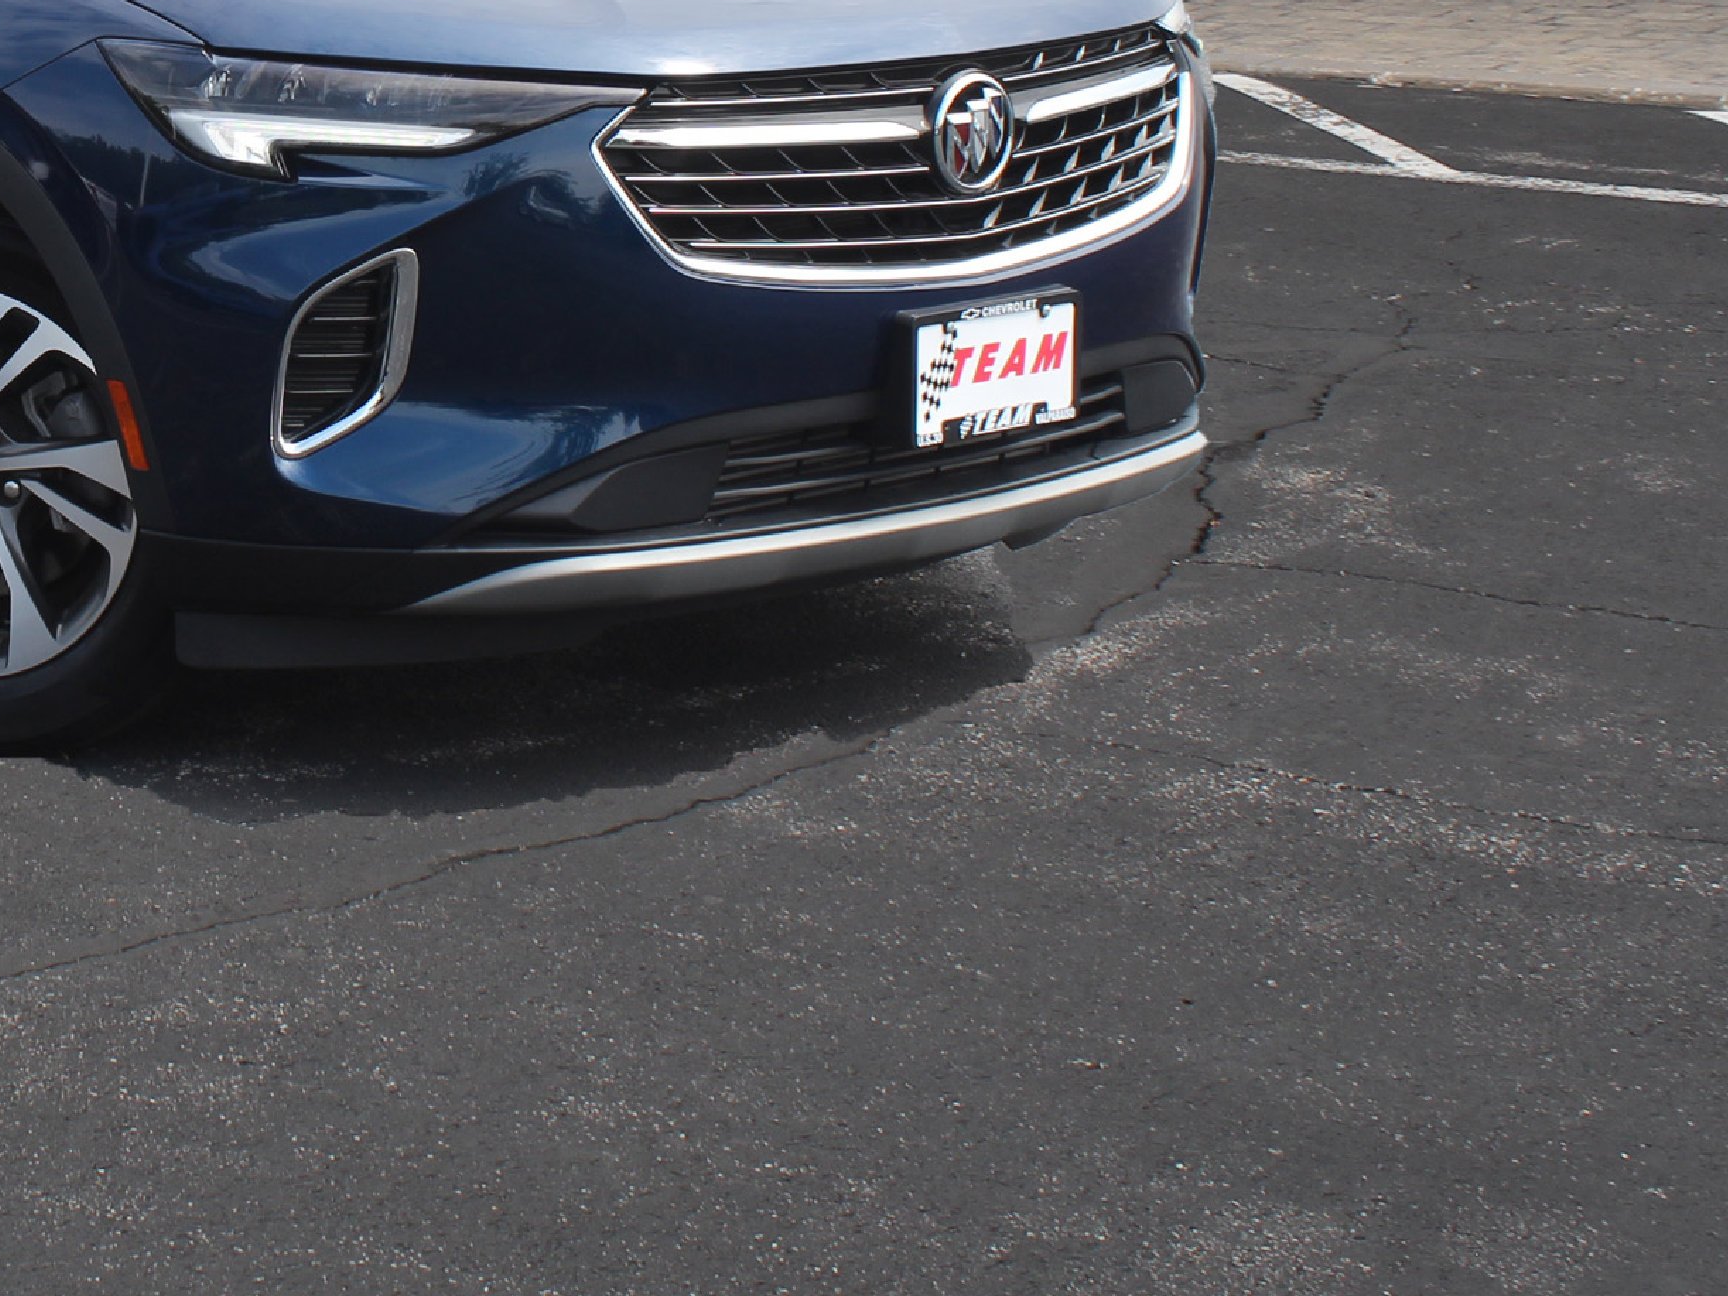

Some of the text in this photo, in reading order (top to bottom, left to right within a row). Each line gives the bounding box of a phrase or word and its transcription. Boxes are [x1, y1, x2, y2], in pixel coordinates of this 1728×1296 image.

[981, 299, 1038, 318] CHEVROLET
[950, 331, 1068, 388] TEAM
[972, 403, 1033, 435] TEAM
